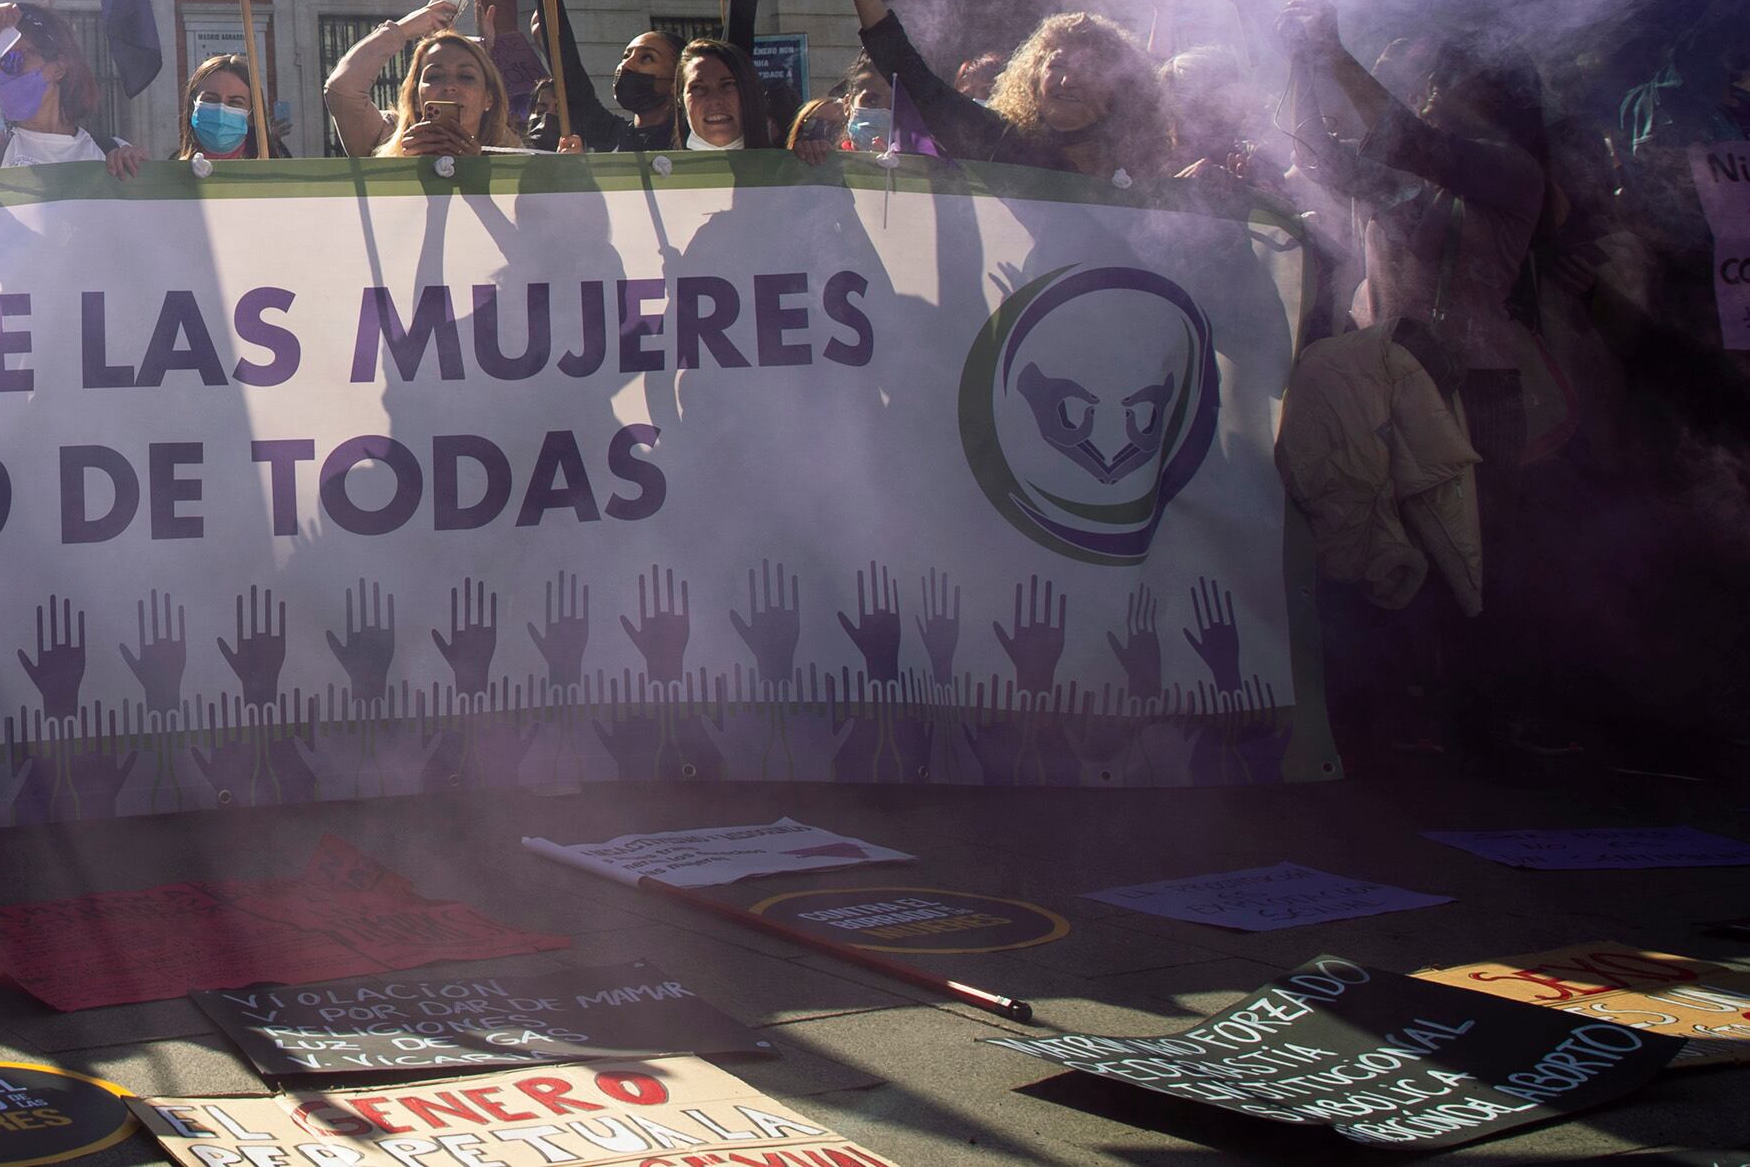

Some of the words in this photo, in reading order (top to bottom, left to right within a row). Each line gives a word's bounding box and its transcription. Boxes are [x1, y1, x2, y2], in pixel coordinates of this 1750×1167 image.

[80, 287, 302, 389] LAS
[348, 269, 875, 385] MUJERES
[58, 440, 204, 545] DE
[249, 423, 667, 538] TODAS
[797, 900, 905, 921] CONTRA
[903, 896, 943, 909] EL
[828, 907, 948, 929] BORRADO
[859, 913, 1013, 940] MUJERES
[1468, 951, 1698, 1001] SEXO
[320, 1003, 397, 1023] POR
[419, 997, 494, 1018] DAR
[508, 995, 561, 1013] DE
[575, 980, 696, 1009] MAMAR
[1191, 959, 1371, 1050] FORZADO
[274, 1038, 361, 1053] LUZ
[392, 1035, 459, 1051] DE
[485, 1027, 589, 1047] GAS
[287, 1053, 331, 1069] V.
[1492, 1022, 1642, 1103] ABORTO
[7, 1093, 29, 1101] DE
[15, 1099, 49, 1108] LAS
[153, 1104, 278, 1141] EL
[290, 1069, 670, 1137] GENERO
[680, 1105, 828, 1141] LA
